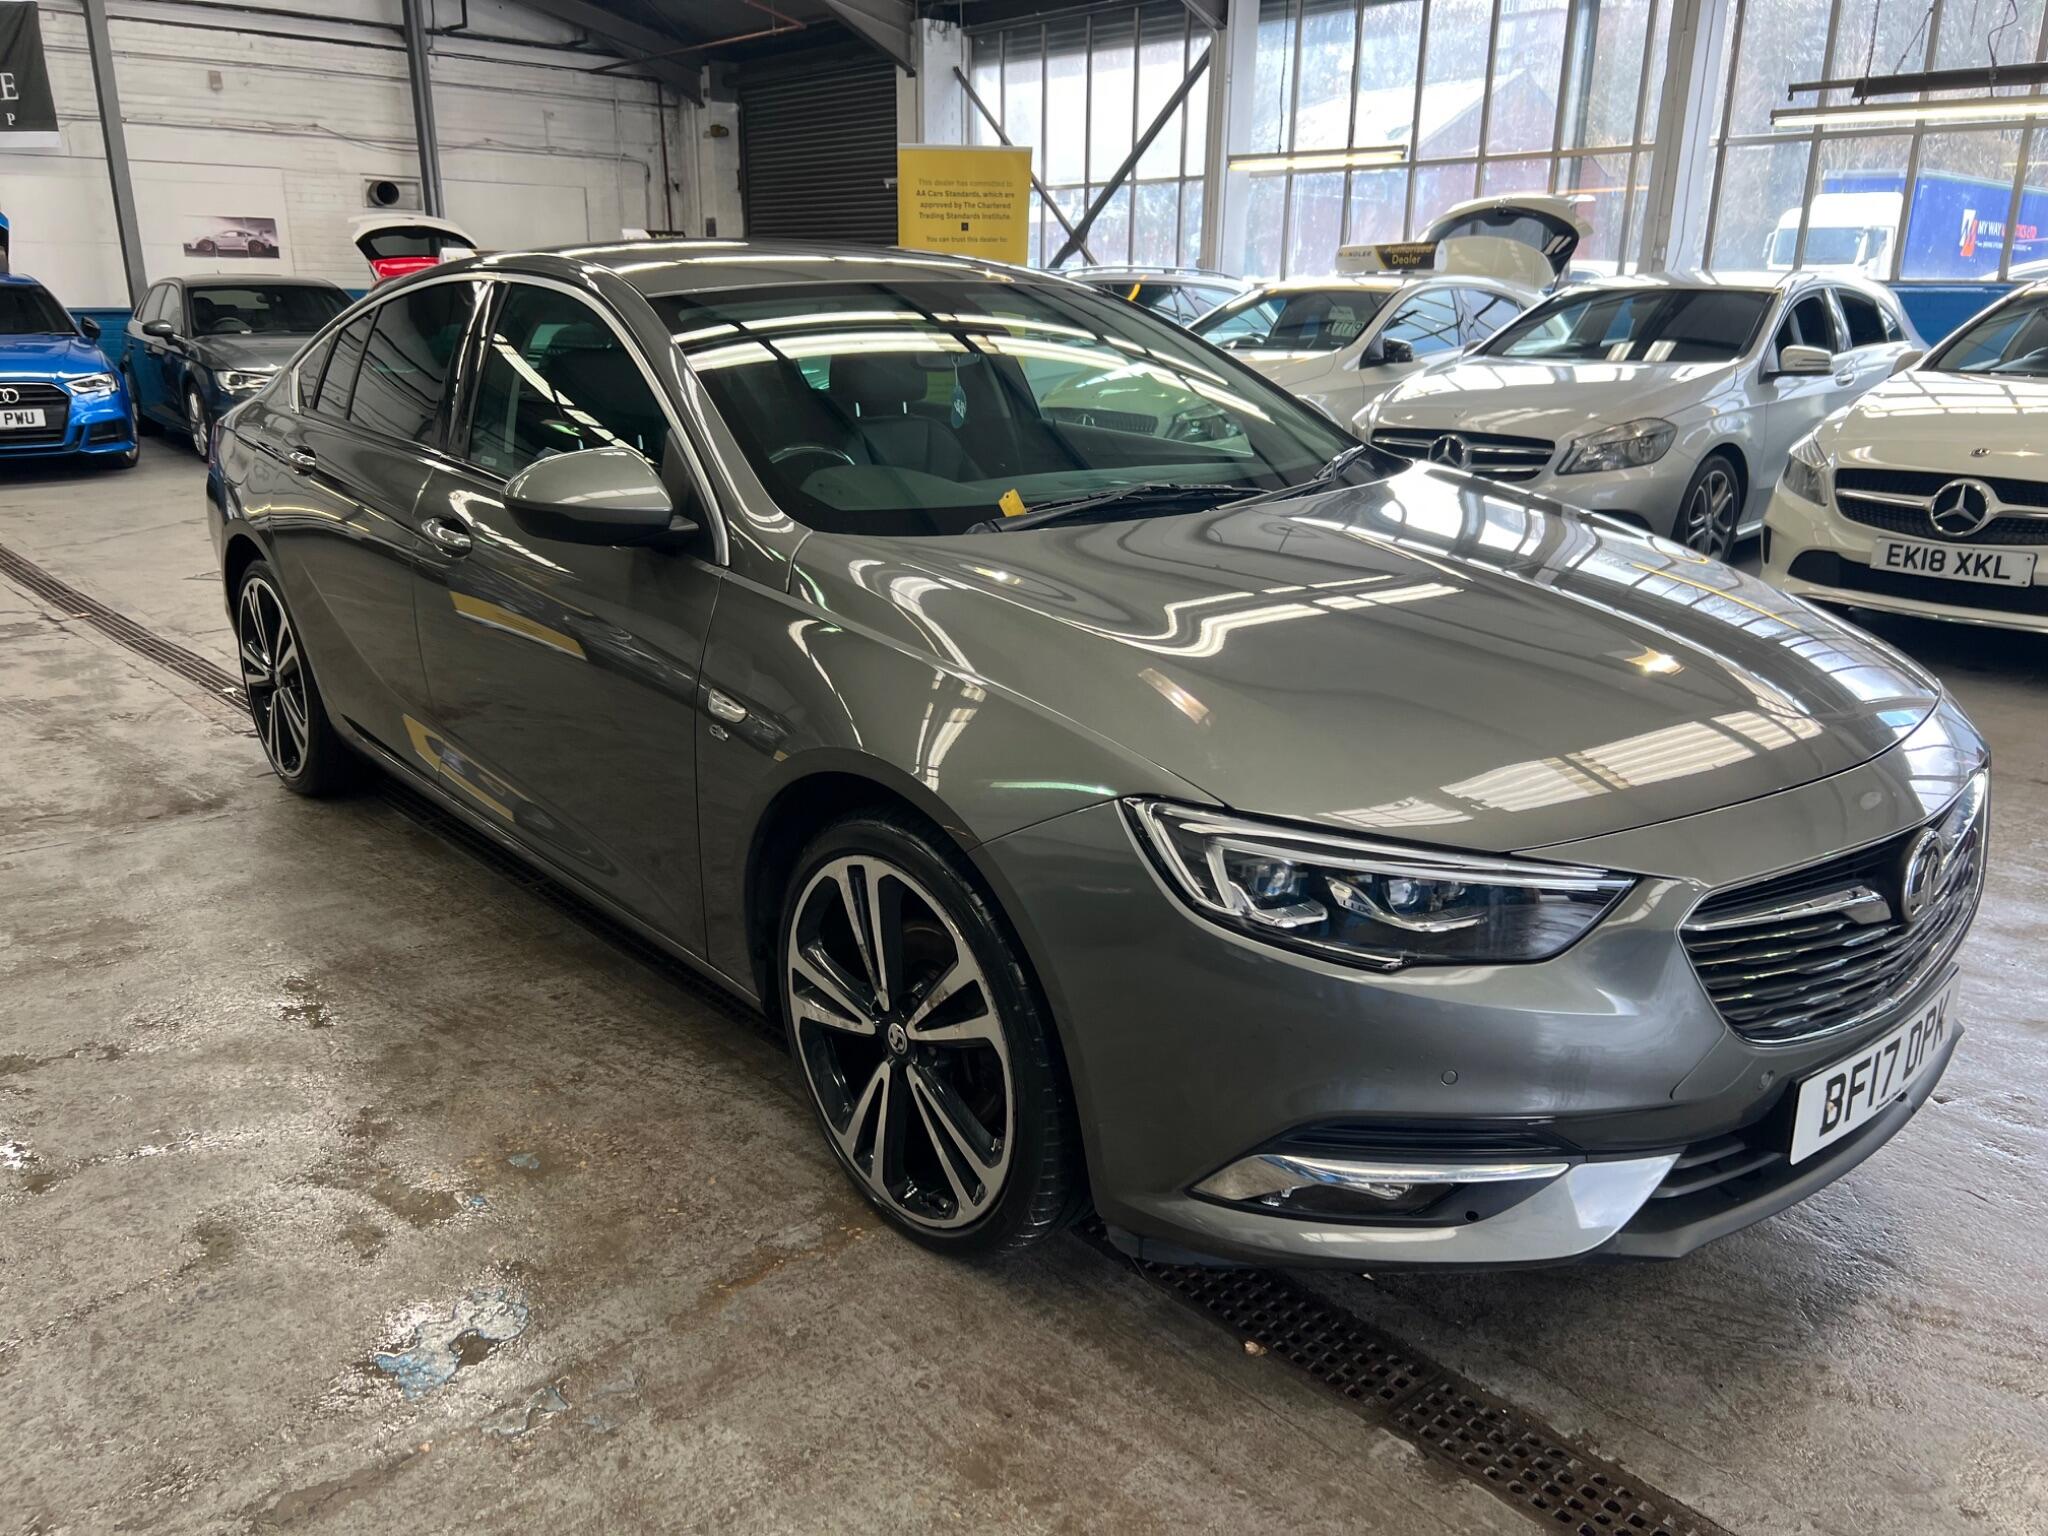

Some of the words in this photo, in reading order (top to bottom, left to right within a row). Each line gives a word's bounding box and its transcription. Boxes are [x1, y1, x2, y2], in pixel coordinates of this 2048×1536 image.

[916, 189, 926, 197] AA
[927, 190, 943, 198] Cars
[983, 191, 1003, 199] which
[920, 202, 953, 210] approved
[954, 201, 962, 210] by
[964, 201, 976, 209] The
[977, 201, 1012, 209] Chartered
[919, 211, 945, 221] Trading
[946, 212, 981, 220] Standards
[1391, 254, 1421, 265] Dealer
[4, 411, 35, 425] PWU
[1886, 543, 1946, 572] EK18
[1953, 551, 2010, 580] XKL
[1819, 1037, 1901, 1137] BF17
[1903, 989, 1951, 1081] DPK
